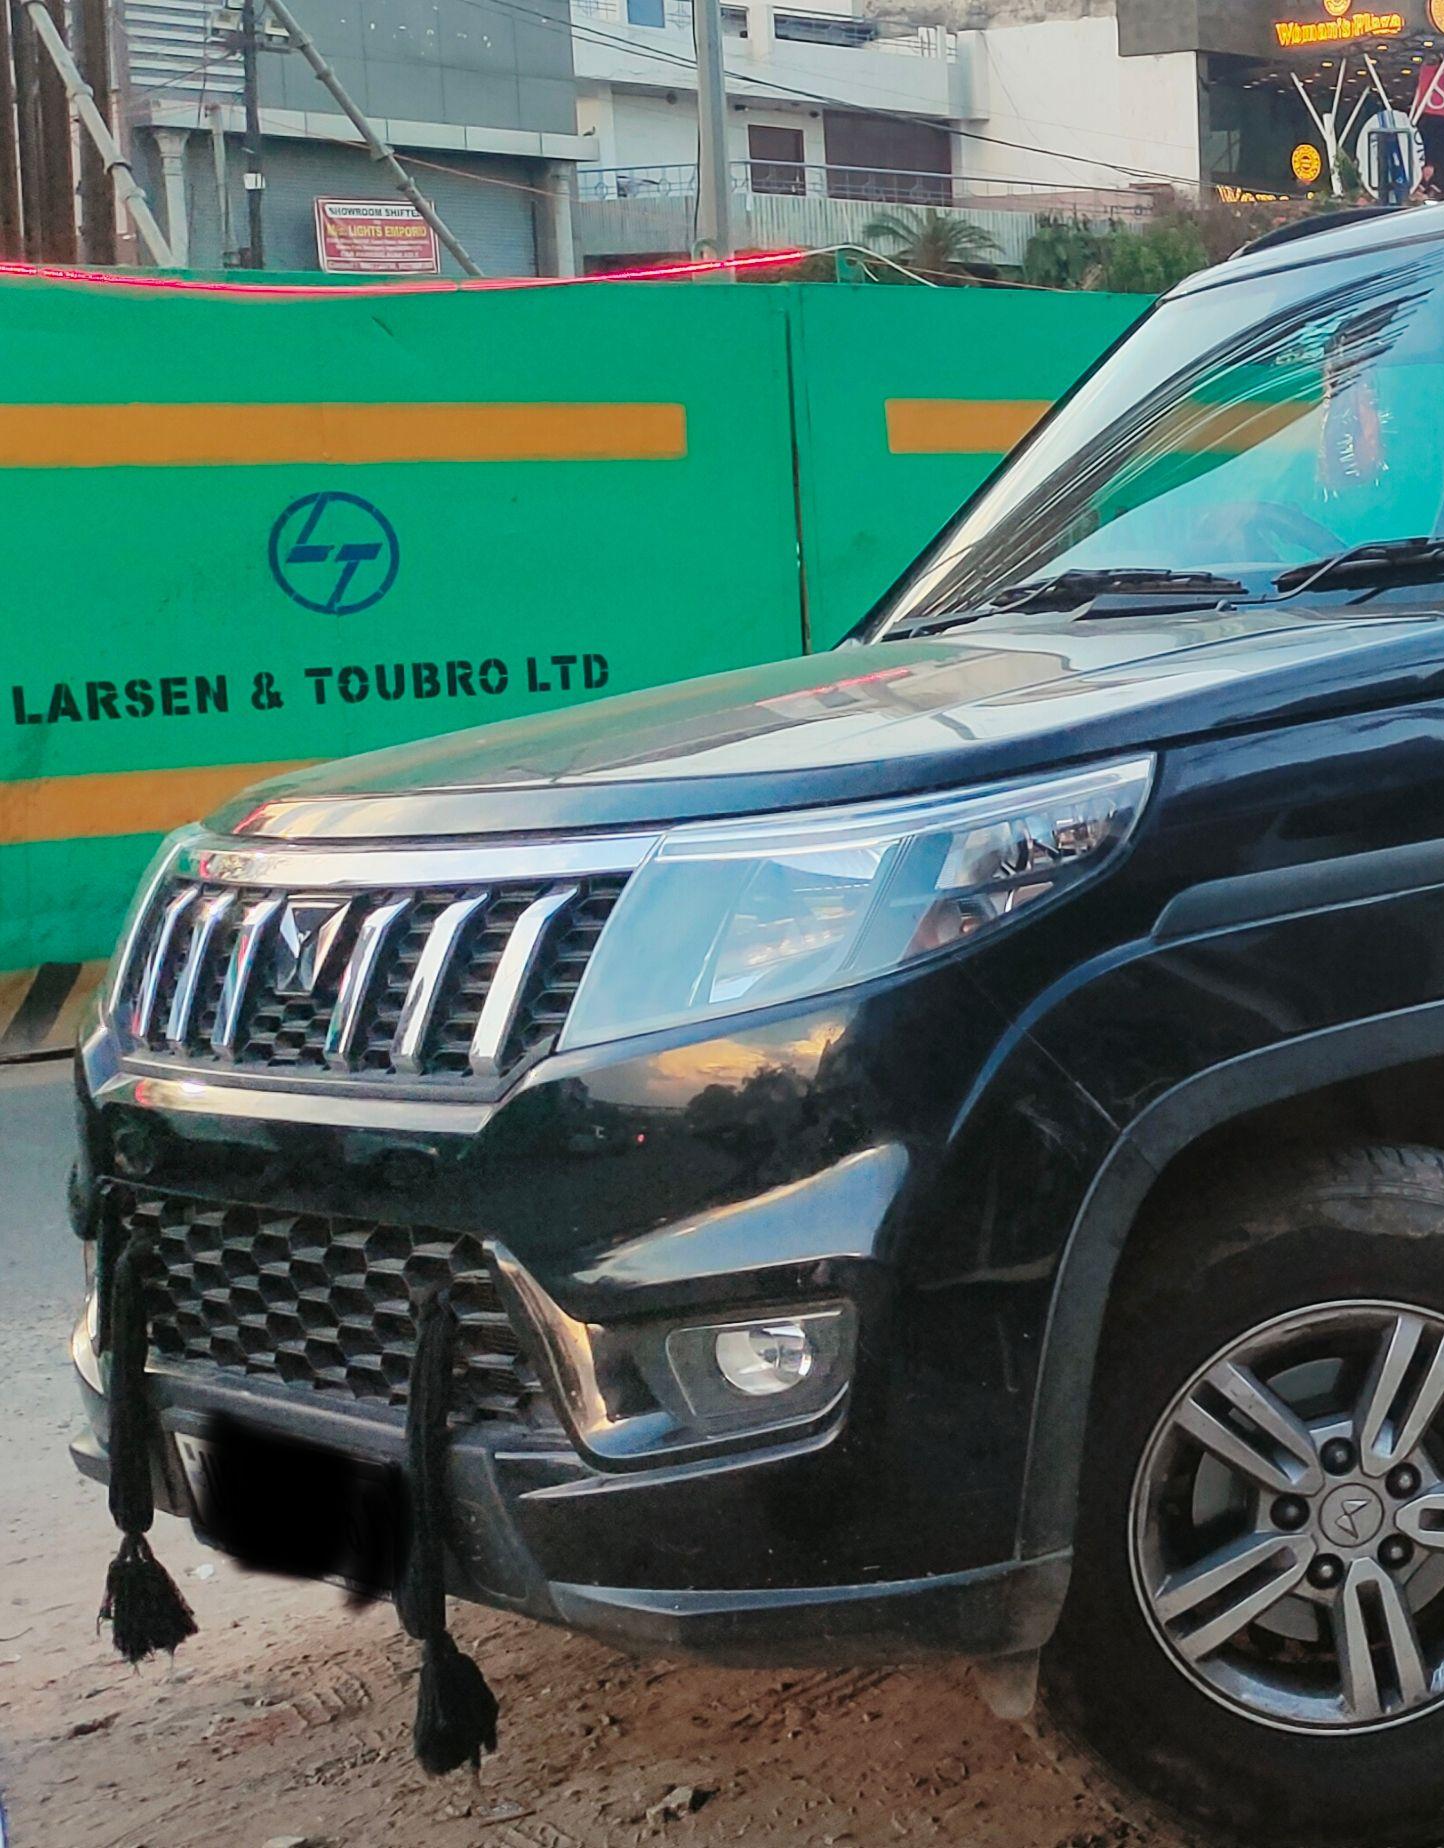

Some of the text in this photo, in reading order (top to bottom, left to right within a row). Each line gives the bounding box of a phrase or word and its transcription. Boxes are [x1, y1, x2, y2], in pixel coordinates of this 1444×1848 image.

[1276, 13, 1404, 46] Woman's Plaza
[328, 207, 382, 217] SHOWROOM
[348, 224, 383, 237] LIGHTS
[12, 653, 610, 725] LARSEN & TOUBRO LTD
